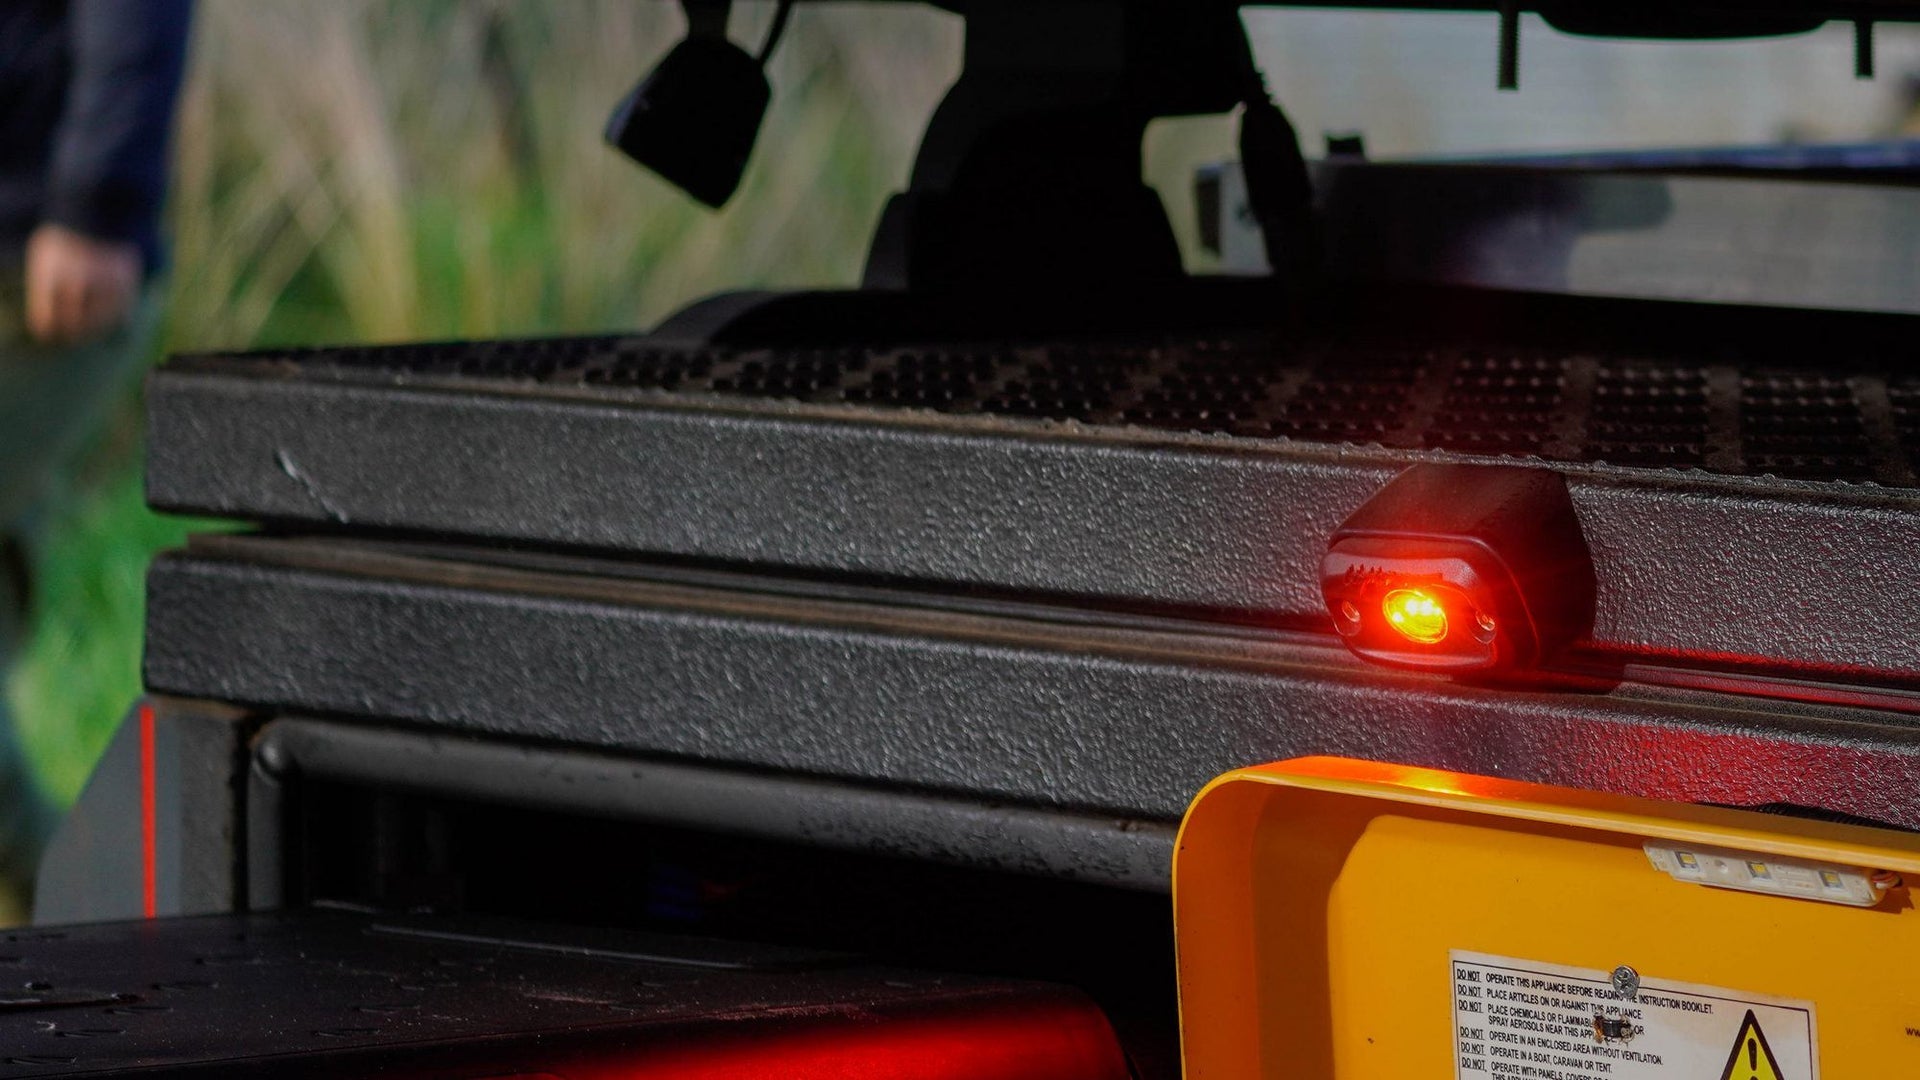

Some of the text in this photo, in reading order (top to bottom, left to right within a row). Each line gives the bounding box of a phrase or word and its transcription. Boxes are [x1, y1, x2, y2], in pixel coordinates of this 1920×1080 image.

[1457, 969, 1466, 980] DO
[1468, 970, 1480, 982] NOT
[1486, 972, 1515, 986] OPERATE
[1516, 977, 1530, 988] THIS
[1531, 979, 1566, 994] APPLIANCE
[1567, 983, 1593, 998] BEFORE
[1595, 988, 1623, 1001] READIN
[1639, 995, 1680, 1009] INSTRUCTION
[1682, 1001, 1714, 1014] BOOKLET.
[1458, 984, 1467, 995] DO
[1468, 986, 1481, 997] NOT
[1487, 988, 1507, 1000] PLACE
[1509, 991, 1539, 1005] ARTICLES
[1540, 996, 1549, 1006] ON
[1551, 997, 1560, 1008] OR
[1561, 999, 1589, 1012] AGAINST
[1458, 1000, 1468, 1010] DO
[1469, 1001, 1482, 1012] NOT
[1488, 1003, 1508, 1015] PLACE
[1510, 1007, 1546, 1021] CHEMICALS
[1547, 1012, 1556, 1022] OR
[1558, 1014, 1593, 1027] FLAMMABL
[1488, 1015, 1509, 1027] SPRAY
[1510, 1018, 1544, 1032] AEROSOLS
[1545, 1024, 1563, 1034] NEAR
[1564, 1027, 1579, 1037] THIS
[1460, 1026, 1663, 1065] DO NOT OPERATE IN AN ENCLOSED AREA WITHOUT VENTILATION.
[1461, 1042, 1470, 1052] DO
[1472, 1043, 1485, 1055] NOT
[1490, 1046, 1519, 1060] OPERATE
[1520, 1051, 1527, 1060] IN
[1534, 1053, 1552, 1065] BOAT,
[1553, 1056, 1583, 1069] CARAVAN
[1584, 1060, 1594, 1071] OR
[1595, 1061, 1612, 1073] TENT.
[1461, 1057, 1471, 1068] DO
[1491, 1061, 1520, 1075] OPERATE
[1521, 1066, 1537, 1077] WITH
